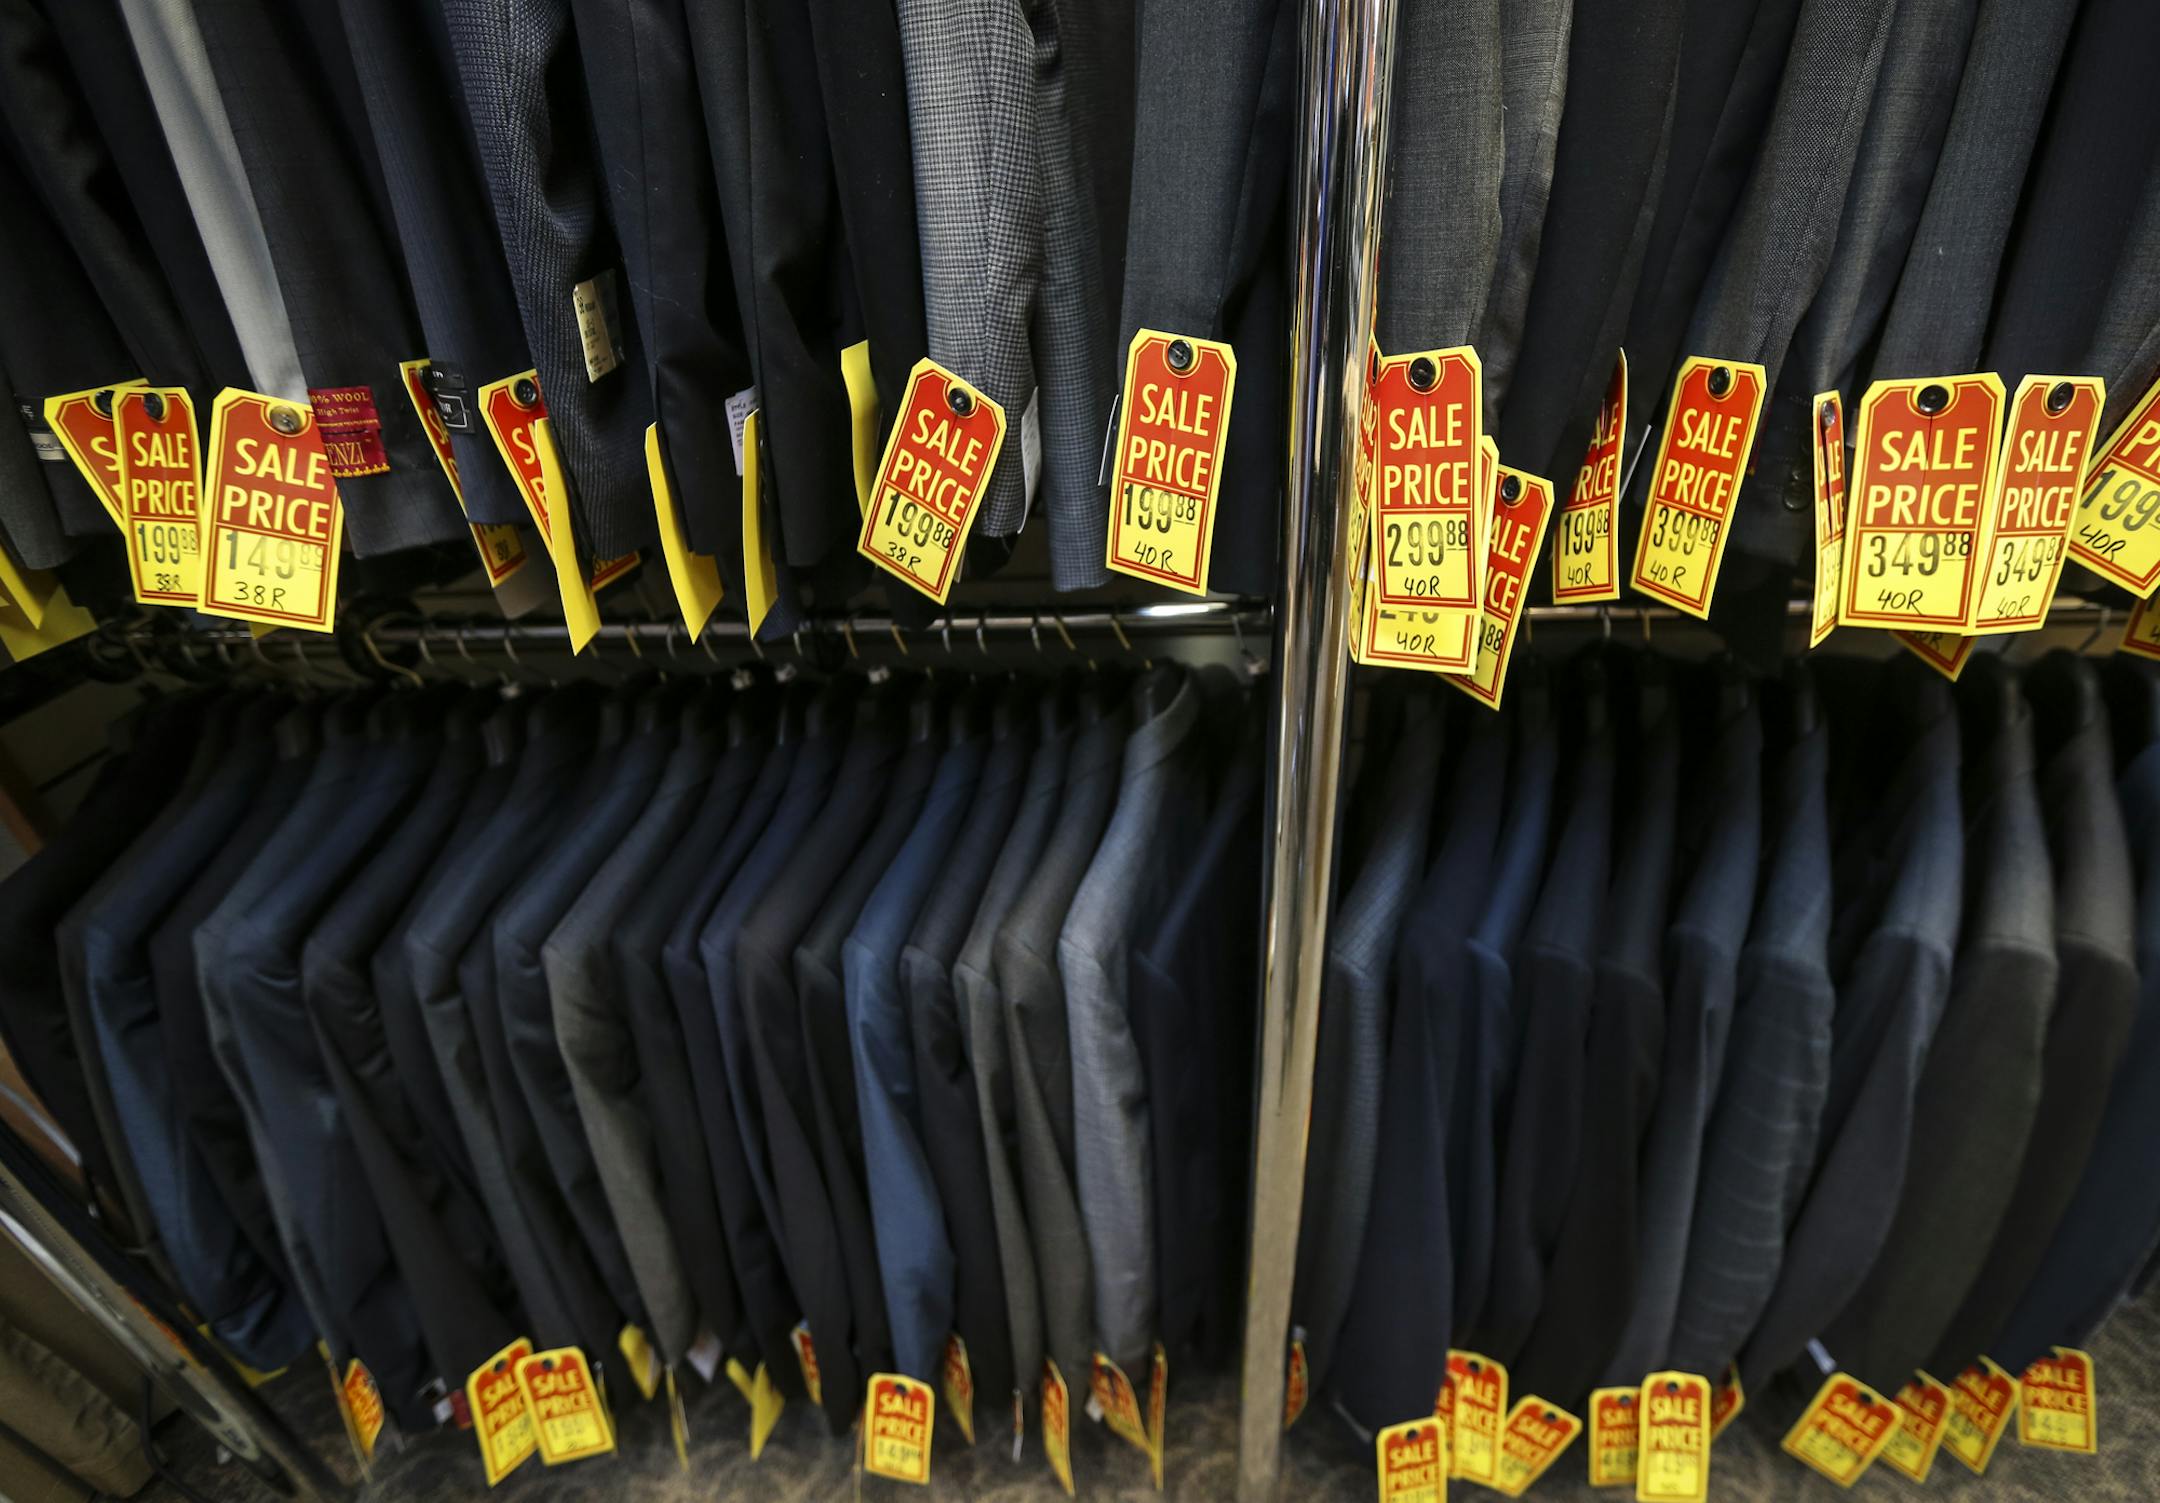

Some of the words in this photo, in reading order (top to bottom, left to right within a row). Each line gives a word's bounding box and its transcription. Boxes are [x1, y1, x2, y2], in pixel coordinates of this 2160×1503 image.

[332, 391, 369, 403] WOOL
[1139, 383, 1214, 437] SALE
[911, 408, 983, 477] SALE
[1388, 402, 1464, 452] SALE
[1589, 402, 1618, 452] ALE
[1678, 407, 1743, 459] SALE
[131, 431, 190, 469] SALE
[234, 437, 328, 490] SALE
[1126, 435, 1211, 493] PRICE
[1879, 427, 1978, 473] SALE
[2014, 430, 2082, 473] SALE
[131, 478, 197, 516] PRICE
[890, 448, 972, 524] PRICE
[1384, 461, 1469, 506] PRICE
[1575, 454, 1616, 503] RICE
[1660, 459, 1733, 515] PRICE
[222, 484, 331, 539] PRICE
[1865, 483, 1979, 526] PRICE
[1999, 486, 2074, 529] PRICE
[1134, 541, 1178, 575] 40R
[1489, 514, 1531, 564] ALE
[2080, 524, 2127, 564] 40R
[884, 542, 922, 577] 38R
[1568, 563, 1595, 587] 40R
[1650, 559, 1686, 589] 40R
[234, 581, 287, 611] 38R
[1404, 575, 1442, 598] 40R
[1877, 589, 1925, 617] 40R
[1996, 595, 2032, 620] 40R
[1396, 630, 1438, 659] 40R
[532, 1368, 581, 1397] SALE
[2026, 1362, 2081, 1390] SALE
[879, 1392, 923, 1420] SALE
[1649, 1395, 1698, 1423] SALE
[2024, 1386, 2088, 1415] PRICE
[875, 1416, 925, 1444] PRICE
[1648, 1426, 1702, 1453] PRICE
[1388, 1439, 1436, 1466] SALE
